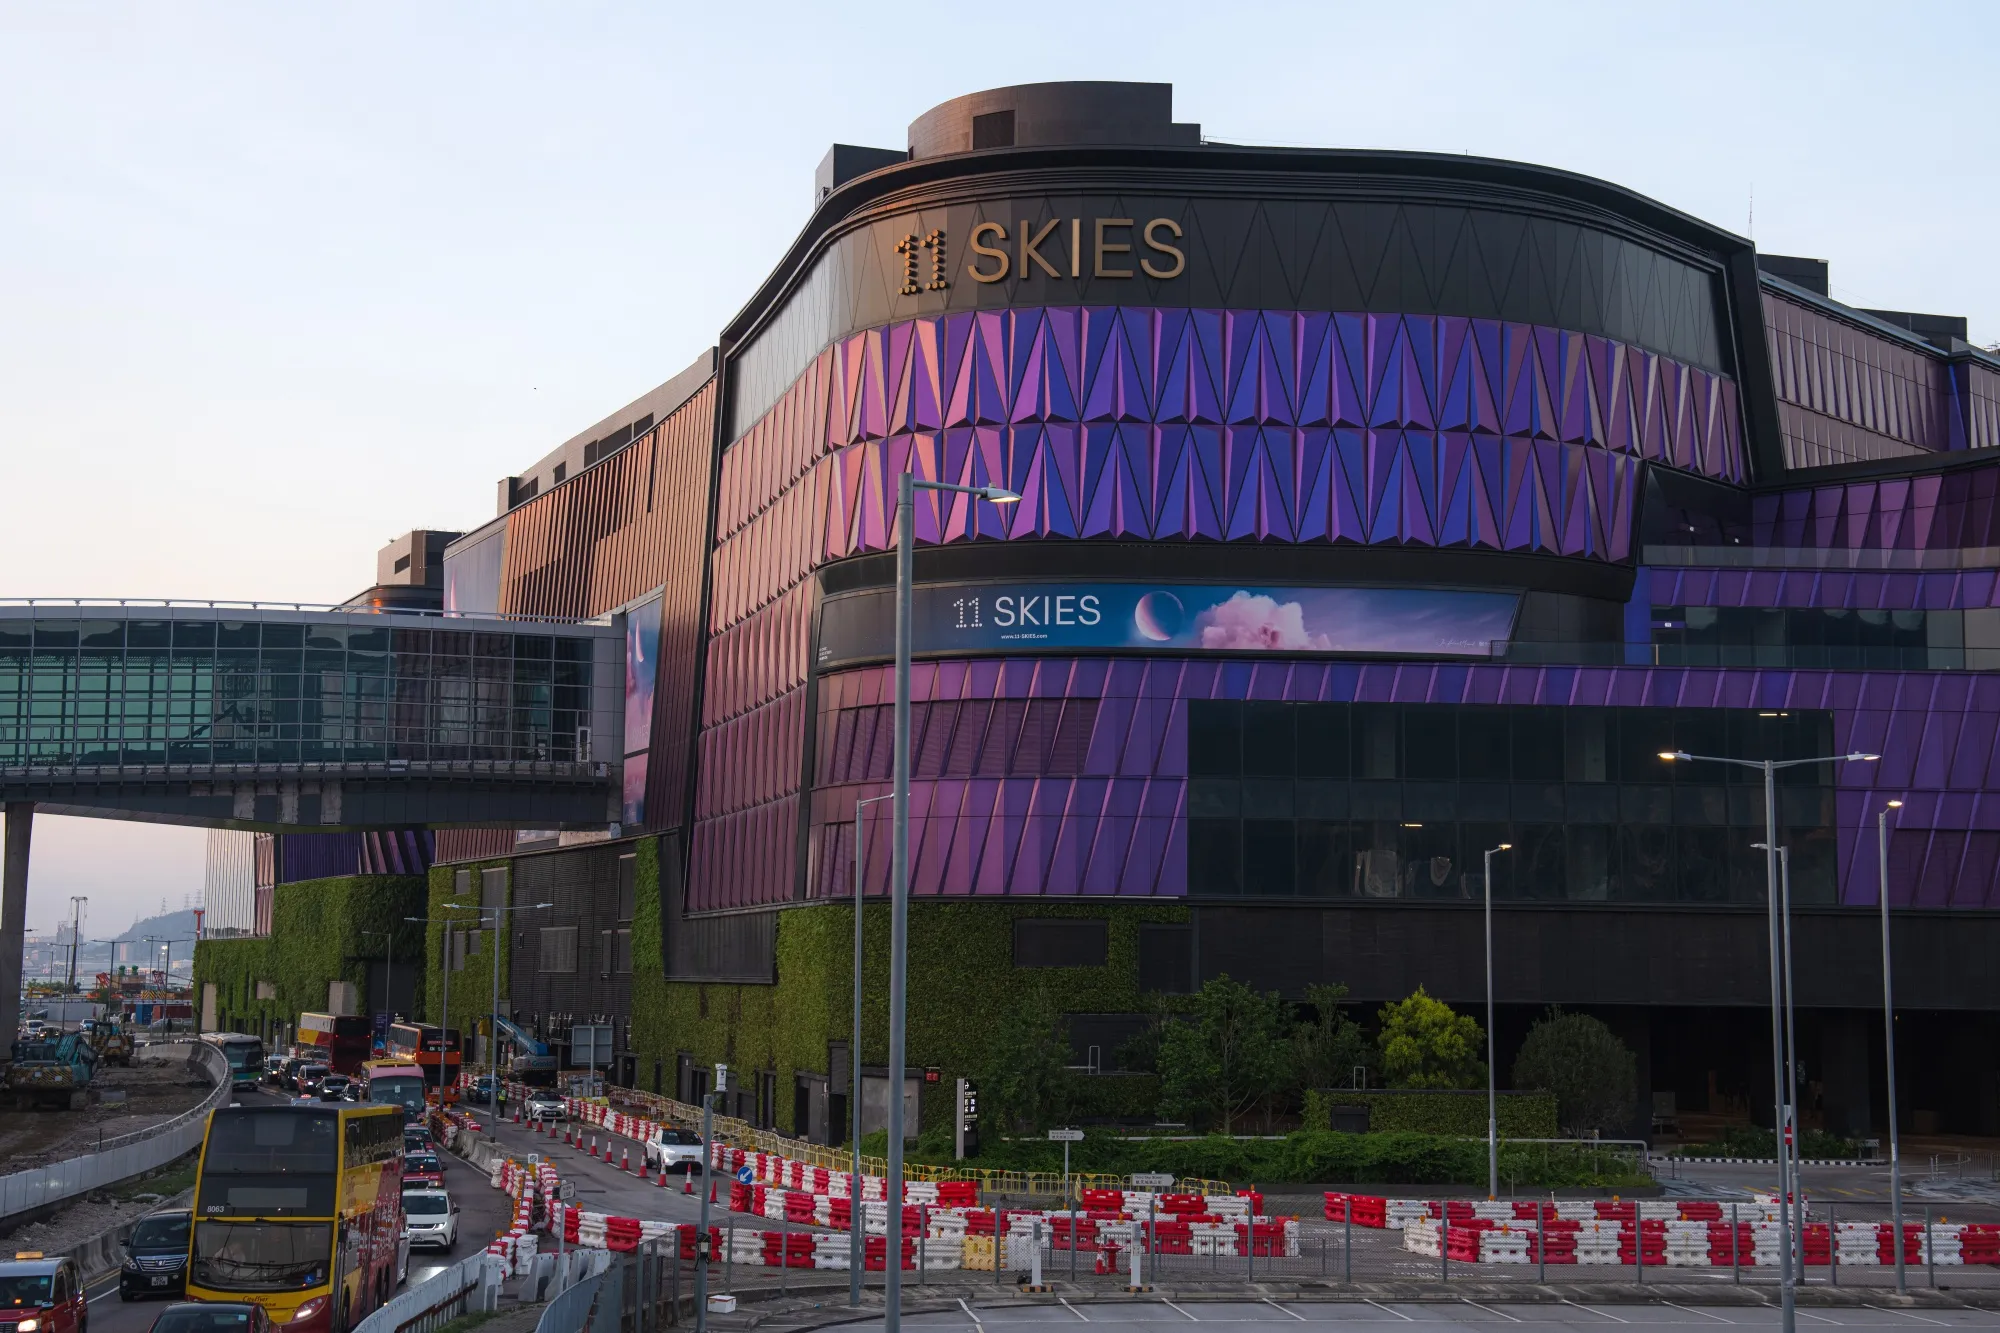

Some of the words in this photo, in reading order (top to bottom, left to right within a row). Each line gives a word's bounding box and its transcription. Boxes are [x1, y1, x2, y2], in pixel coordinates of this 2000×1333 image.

[894, 229, 950, 295] 11
[968, 218, 1187, 284] SKIES
[953, 597, 983, 629] 11
[994, 595, 1101, 627] SKIES
[207, 1205, 225, 1213] 8063
